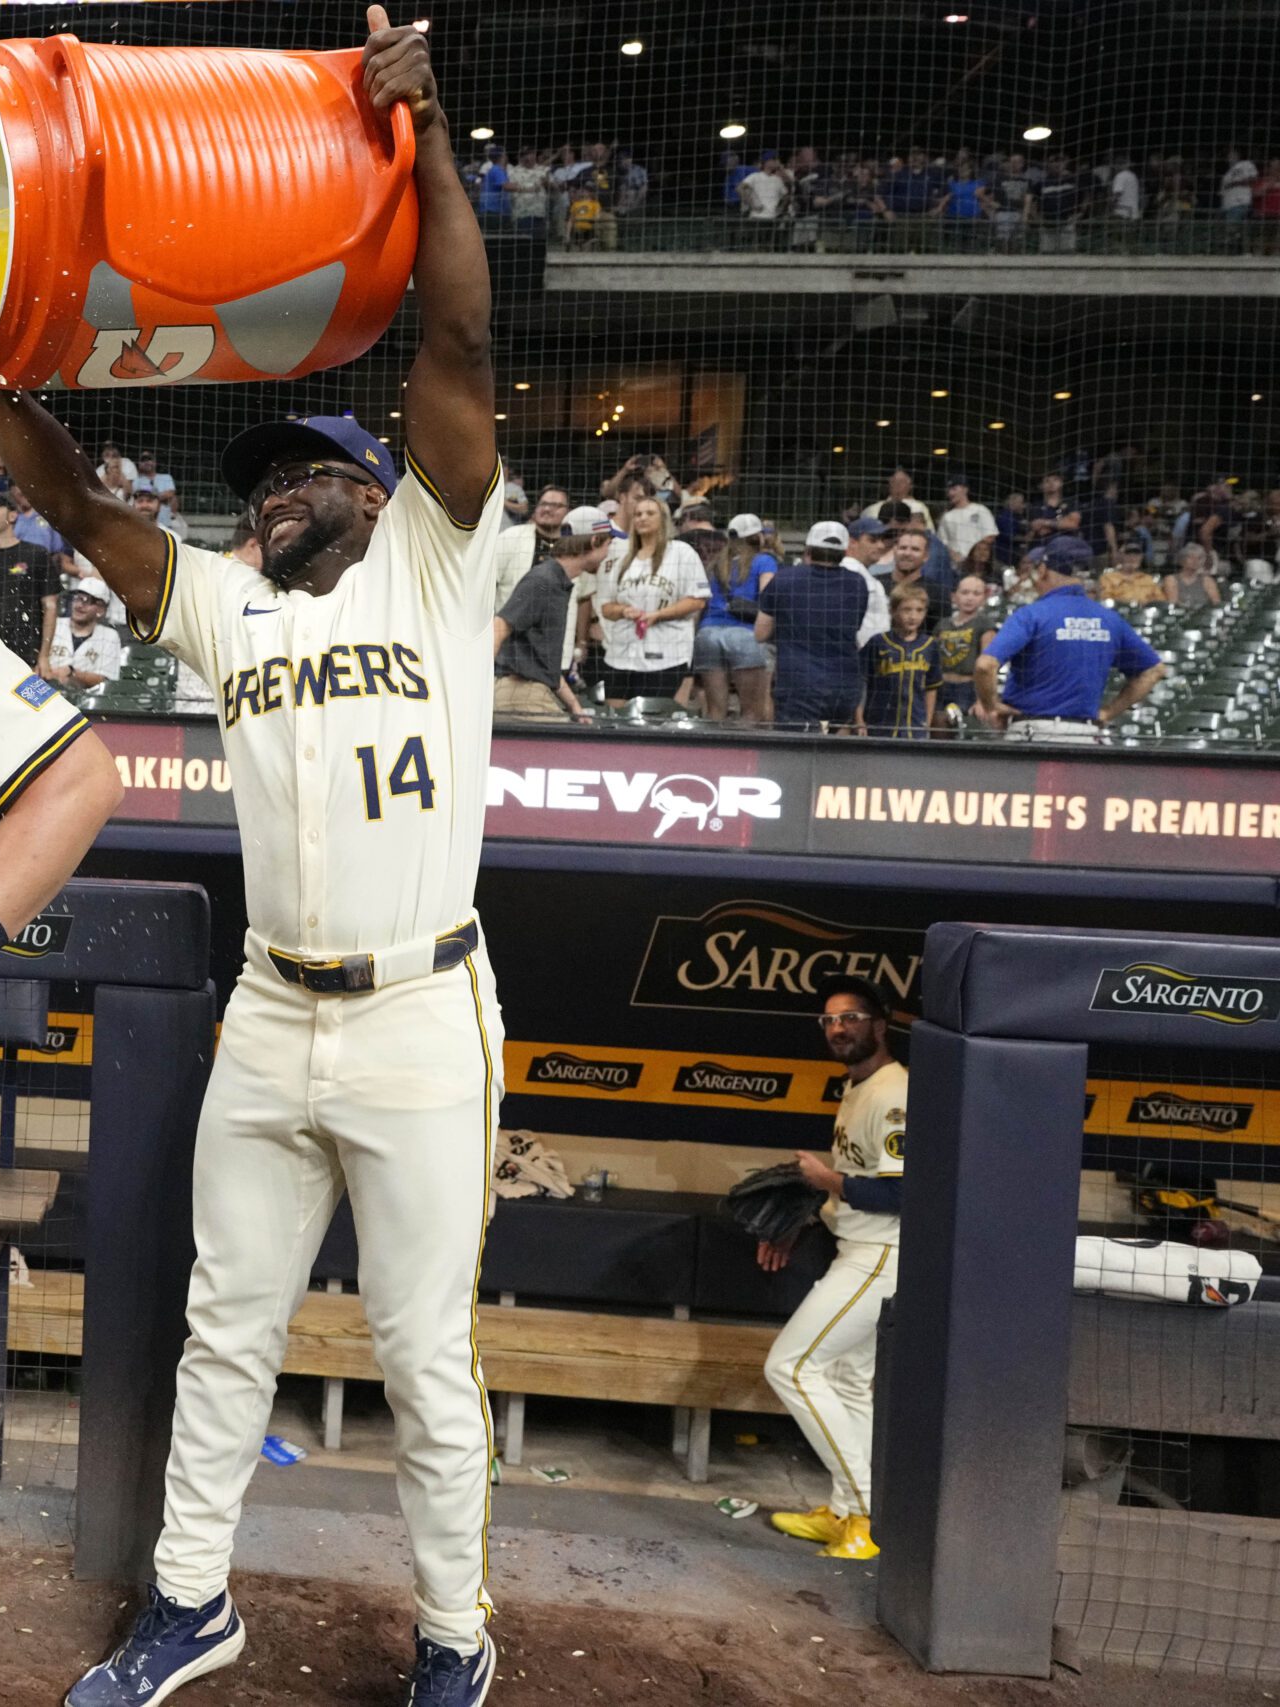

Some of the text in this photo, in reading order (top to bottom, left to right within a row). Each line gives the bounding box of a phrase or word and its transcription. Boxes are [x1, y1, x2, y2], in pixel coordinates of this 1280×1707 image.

[222, 641, 430, 730] BREWERS
[354, 734, 438, 823] 14
[815, 786, 1087, 830] MILWAUKEE'S
[1103, 797, 1280, 838] PREMIER
[1111, 975, 1264, 1013] SARGENTO
